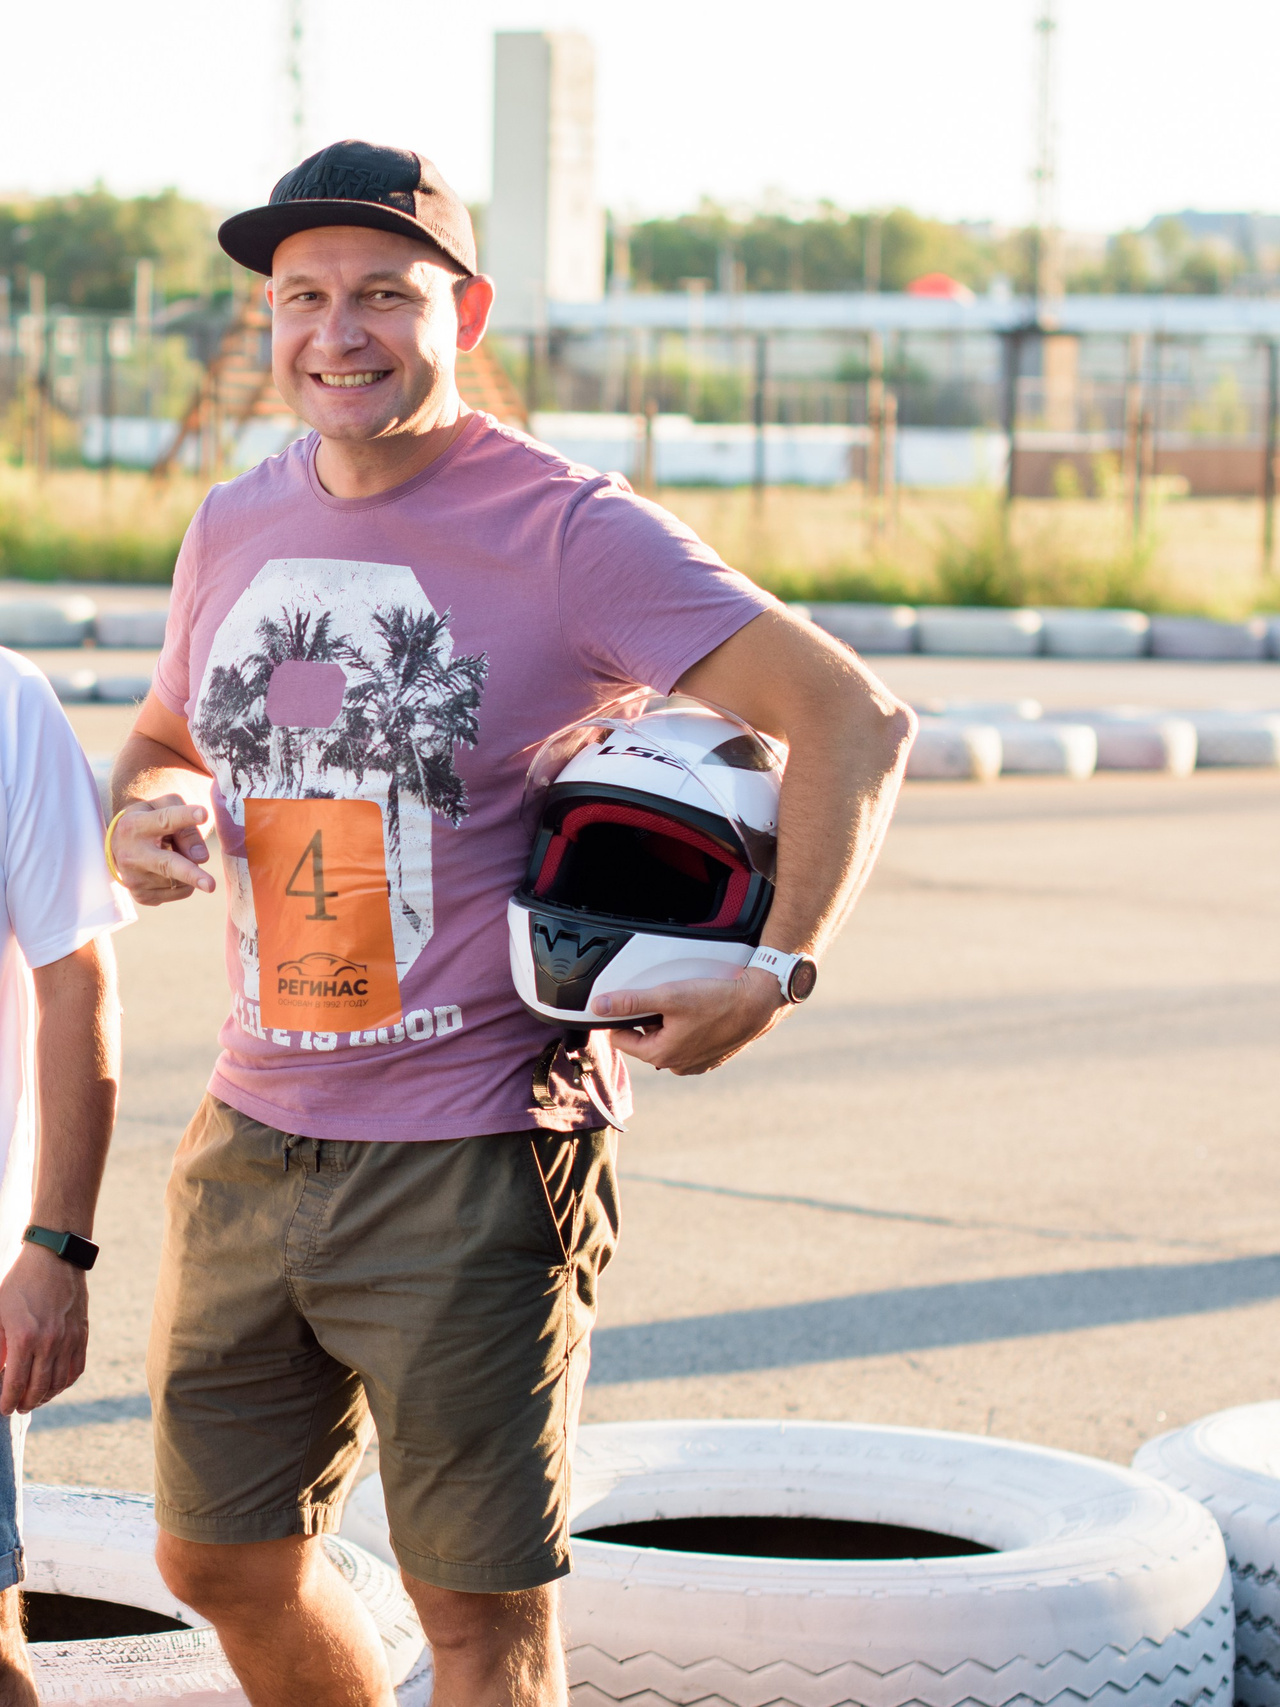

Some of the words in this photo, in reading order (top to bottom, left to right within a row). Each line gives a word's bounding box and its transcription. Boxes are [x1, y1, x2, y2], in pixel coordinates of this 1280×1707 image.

[597, 745, 690, 771] LS2
[285, 828, 339, 921] 4
[277, 977, 369, 997] РЕГИНАС
[277, 998, 314, 1007] ОСНОВАН
[315, 999, 321, 1009] В
[322, 1000, 341, 1009] 1992
[343, 999, 370, 1009] ГОДУ
